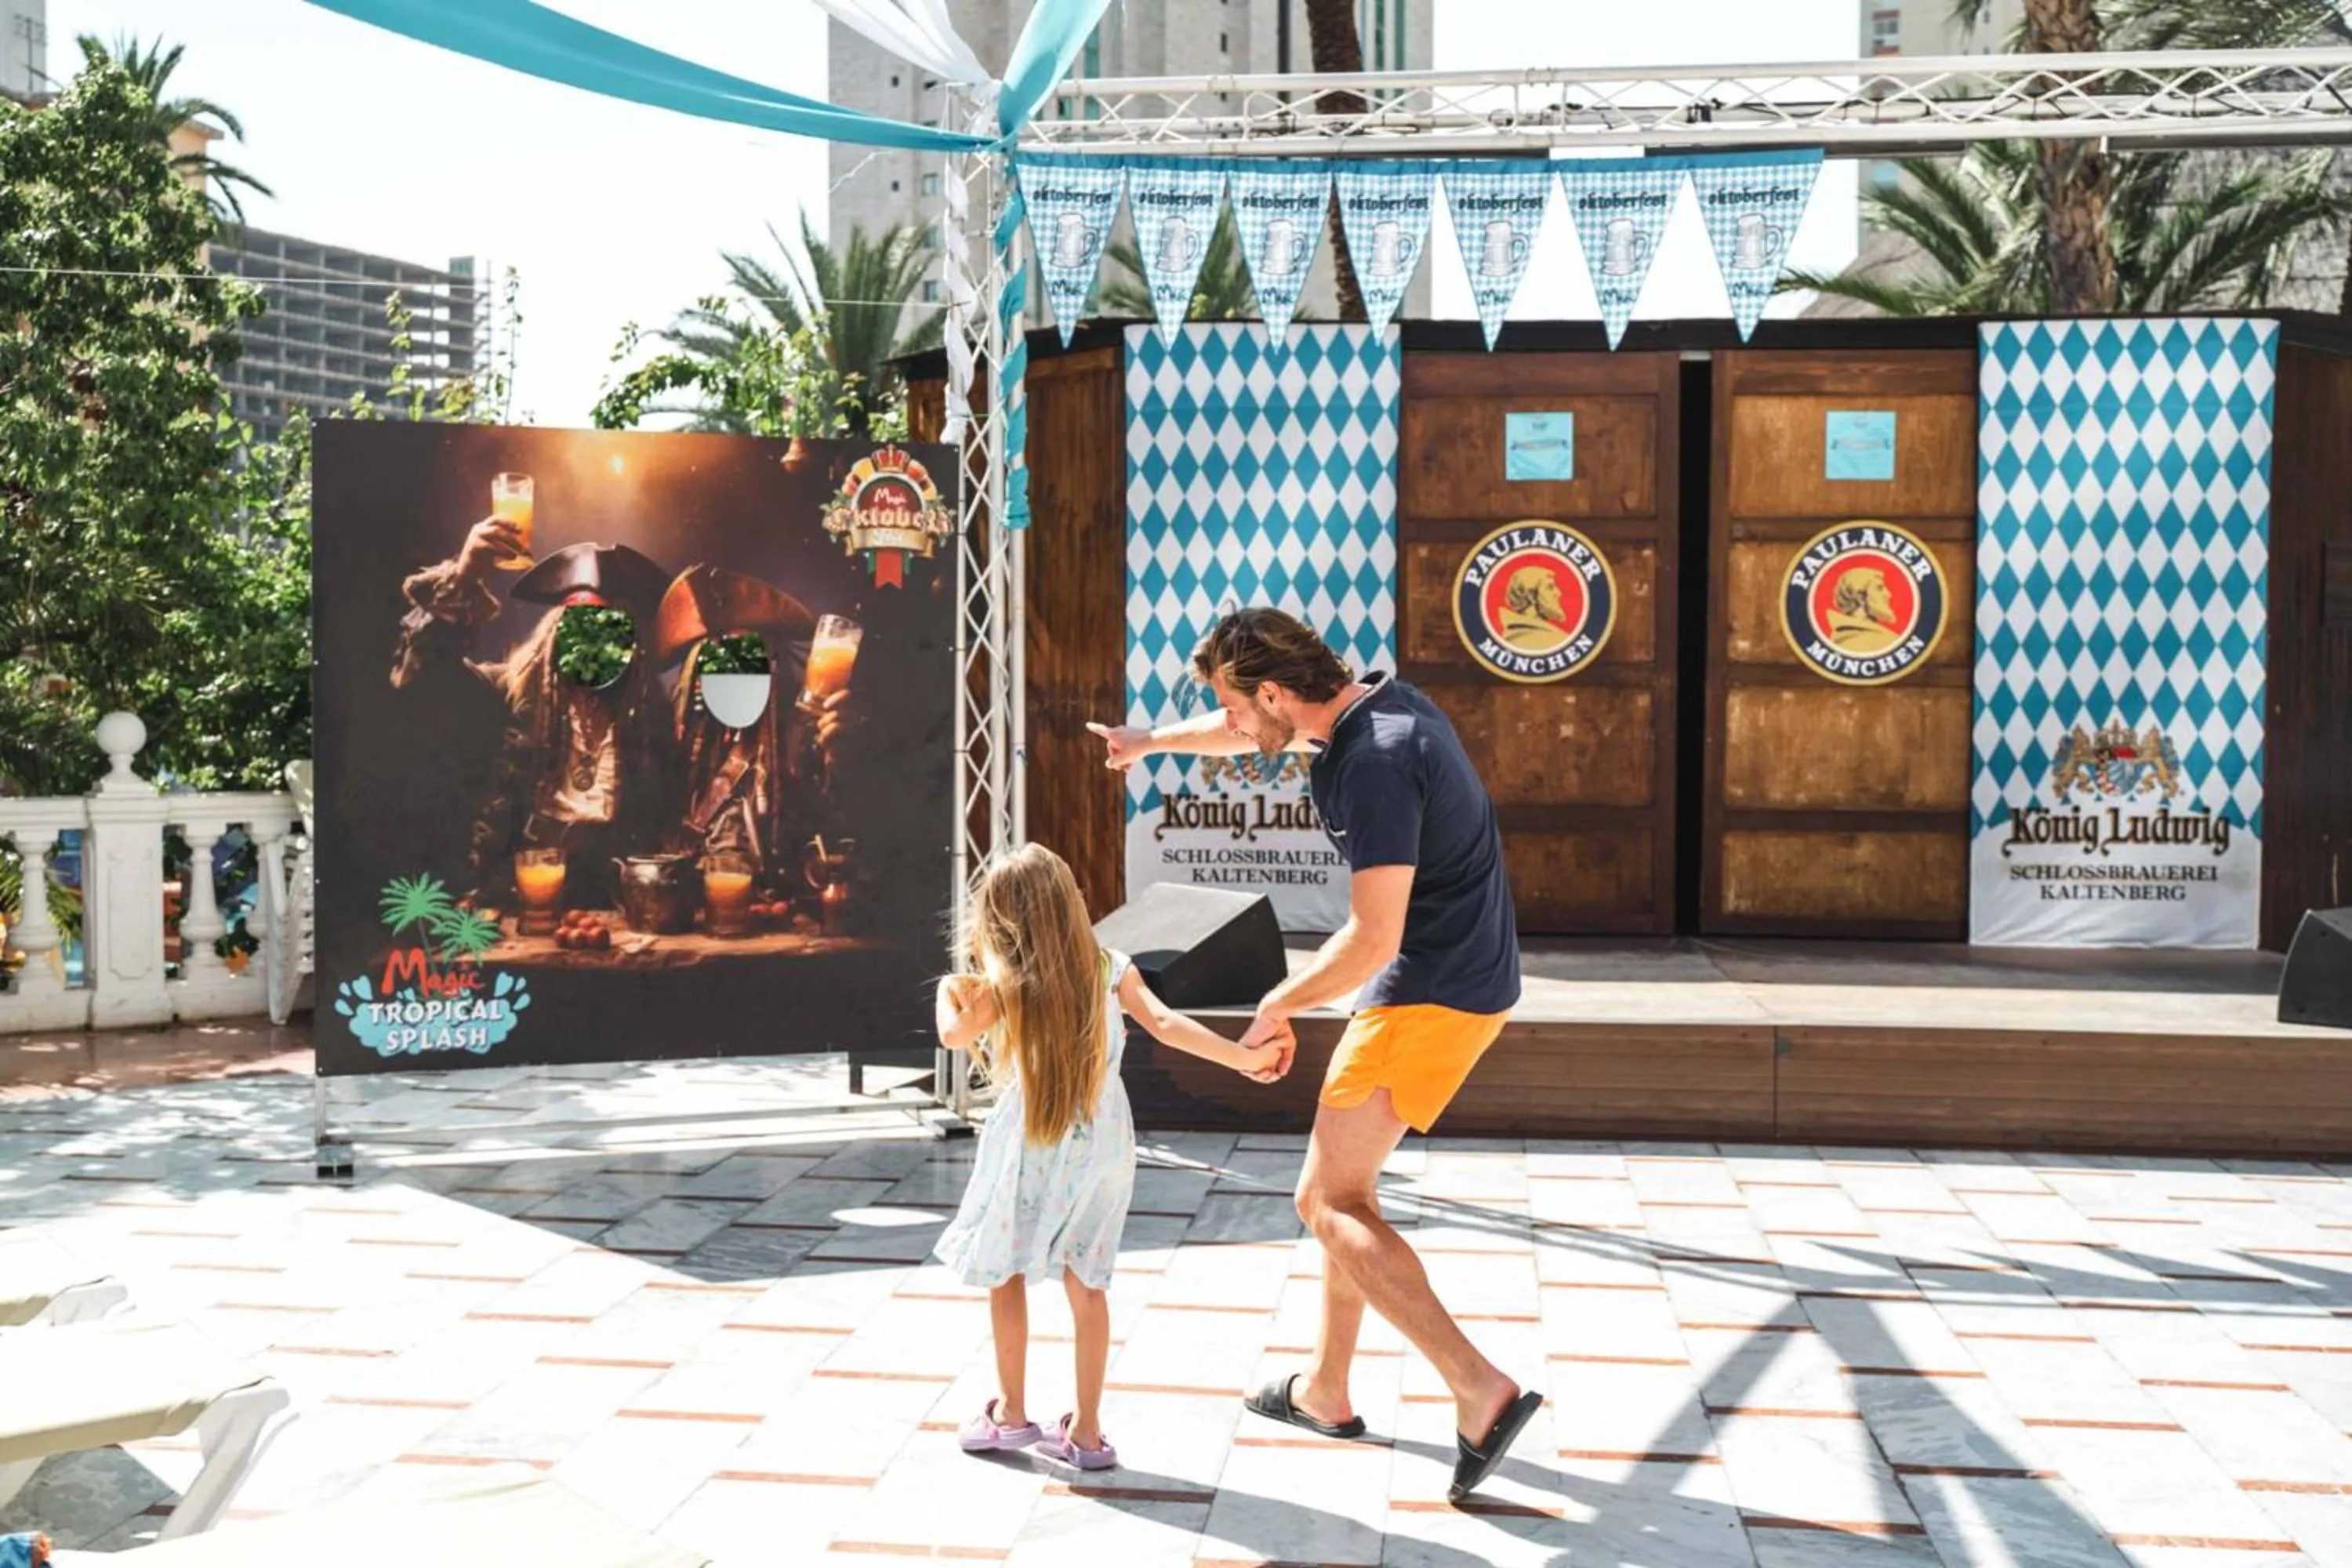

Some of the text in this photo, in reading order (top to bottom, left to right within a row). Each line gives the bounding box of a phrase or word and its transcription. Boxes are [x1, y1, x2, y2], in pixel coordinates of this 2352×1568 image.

[1465, 528, 1601, 587] PAULANER
[1791, 528, 1932, 590] PAULANER
[1479, 634, 1594, 673] MÜNCHEN
[1806, 636, 1926, 677] MÜNCHEN
[1154, 792, 1322, 843] König Lud
[2002, 805, 2230, 858] König Ludwig
[1192, 868, 1328, 885] KALTENBERG
[2009, 864, 2218, 883] SCHLOSSBRAUEREI
[2040, 884, 2187, 901] KALTENBERG
[381, 947, 486, 998] Magic
[368, 998, 503, 1024] TROPICAL
[386, 1025, 488, 1051] SPLASH
